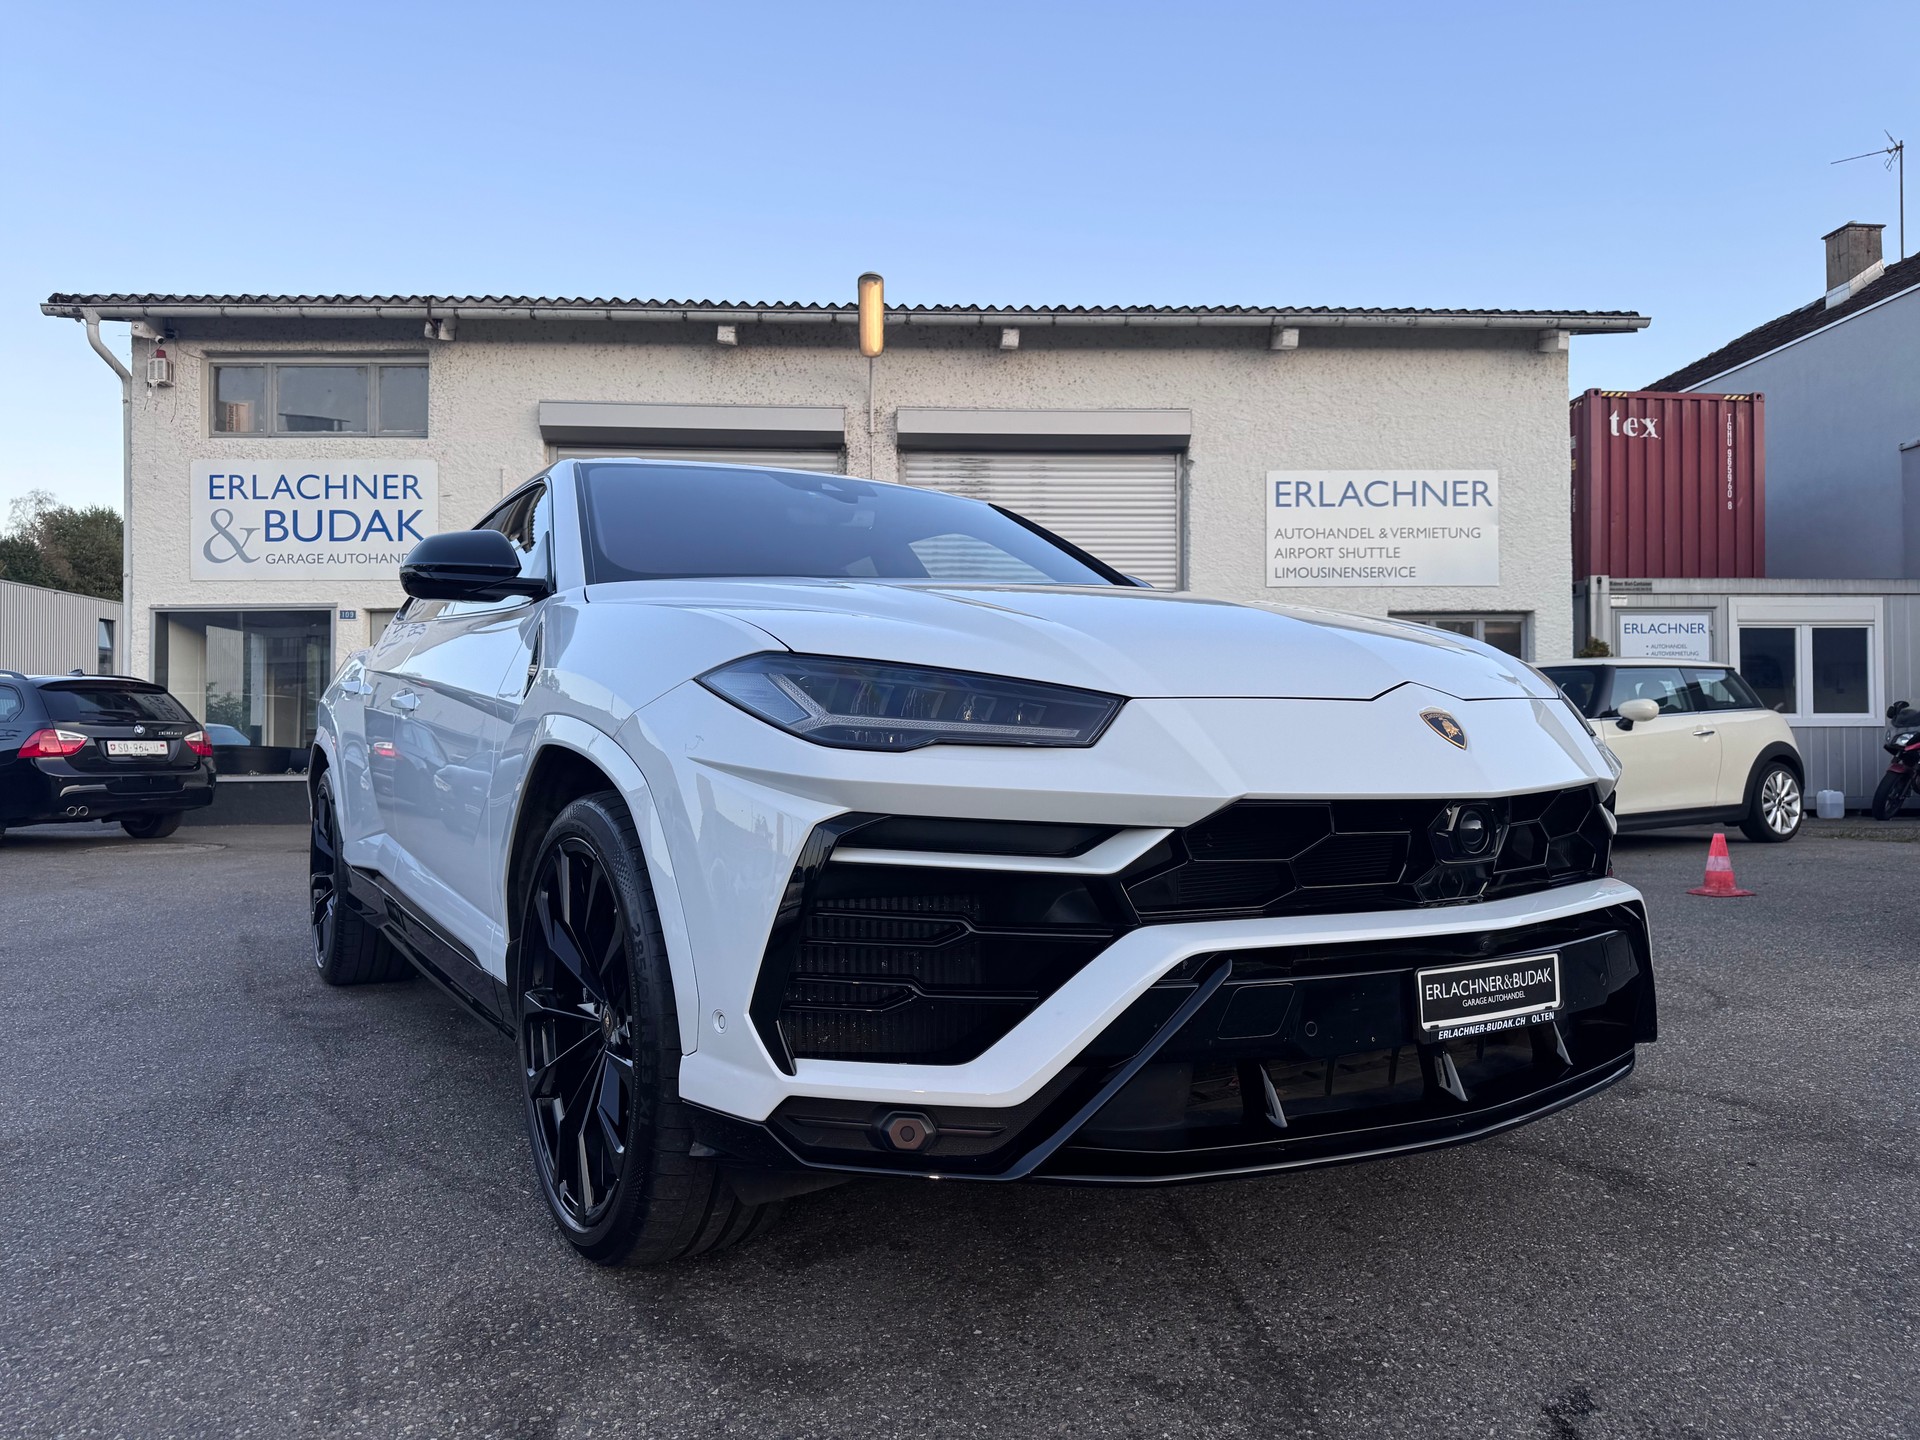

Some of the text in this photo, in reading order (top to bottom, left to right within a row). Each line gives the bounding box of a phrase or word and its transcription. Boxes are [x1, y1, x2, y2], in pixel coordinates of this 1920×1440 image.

[1609, 410, 1659, 439] tex
[209, 474, 423, 500] ERLACHNER
[1274, 480, 1493, 507] ERLACHNER
[1726, 500, 1733, 510] 8
[202, 508, 424, 564] & BUDAK
[1274, 527, 1374, 540] AUTOHANDEL
[1390, 527, 1481, 539] VERMIETUNG
[265, 553, 324, 565] GARAGE
[1274, 547, 1400, 559] AIRPORT SHUTTLE
[1274, 566, 1416, 579] LIMOUSINENSERVICE
[1623, 623, 1706, 634] ERLACHNER
[1425, 967, 1552, 1001] ERLACHNER&BUDAK
[1462, 990, 1526, 1007] GARAGE AUTOHANDEL
[1438, 1011, 1555, 1040] ERLACHNER-BUDAK.CH OLTEN
